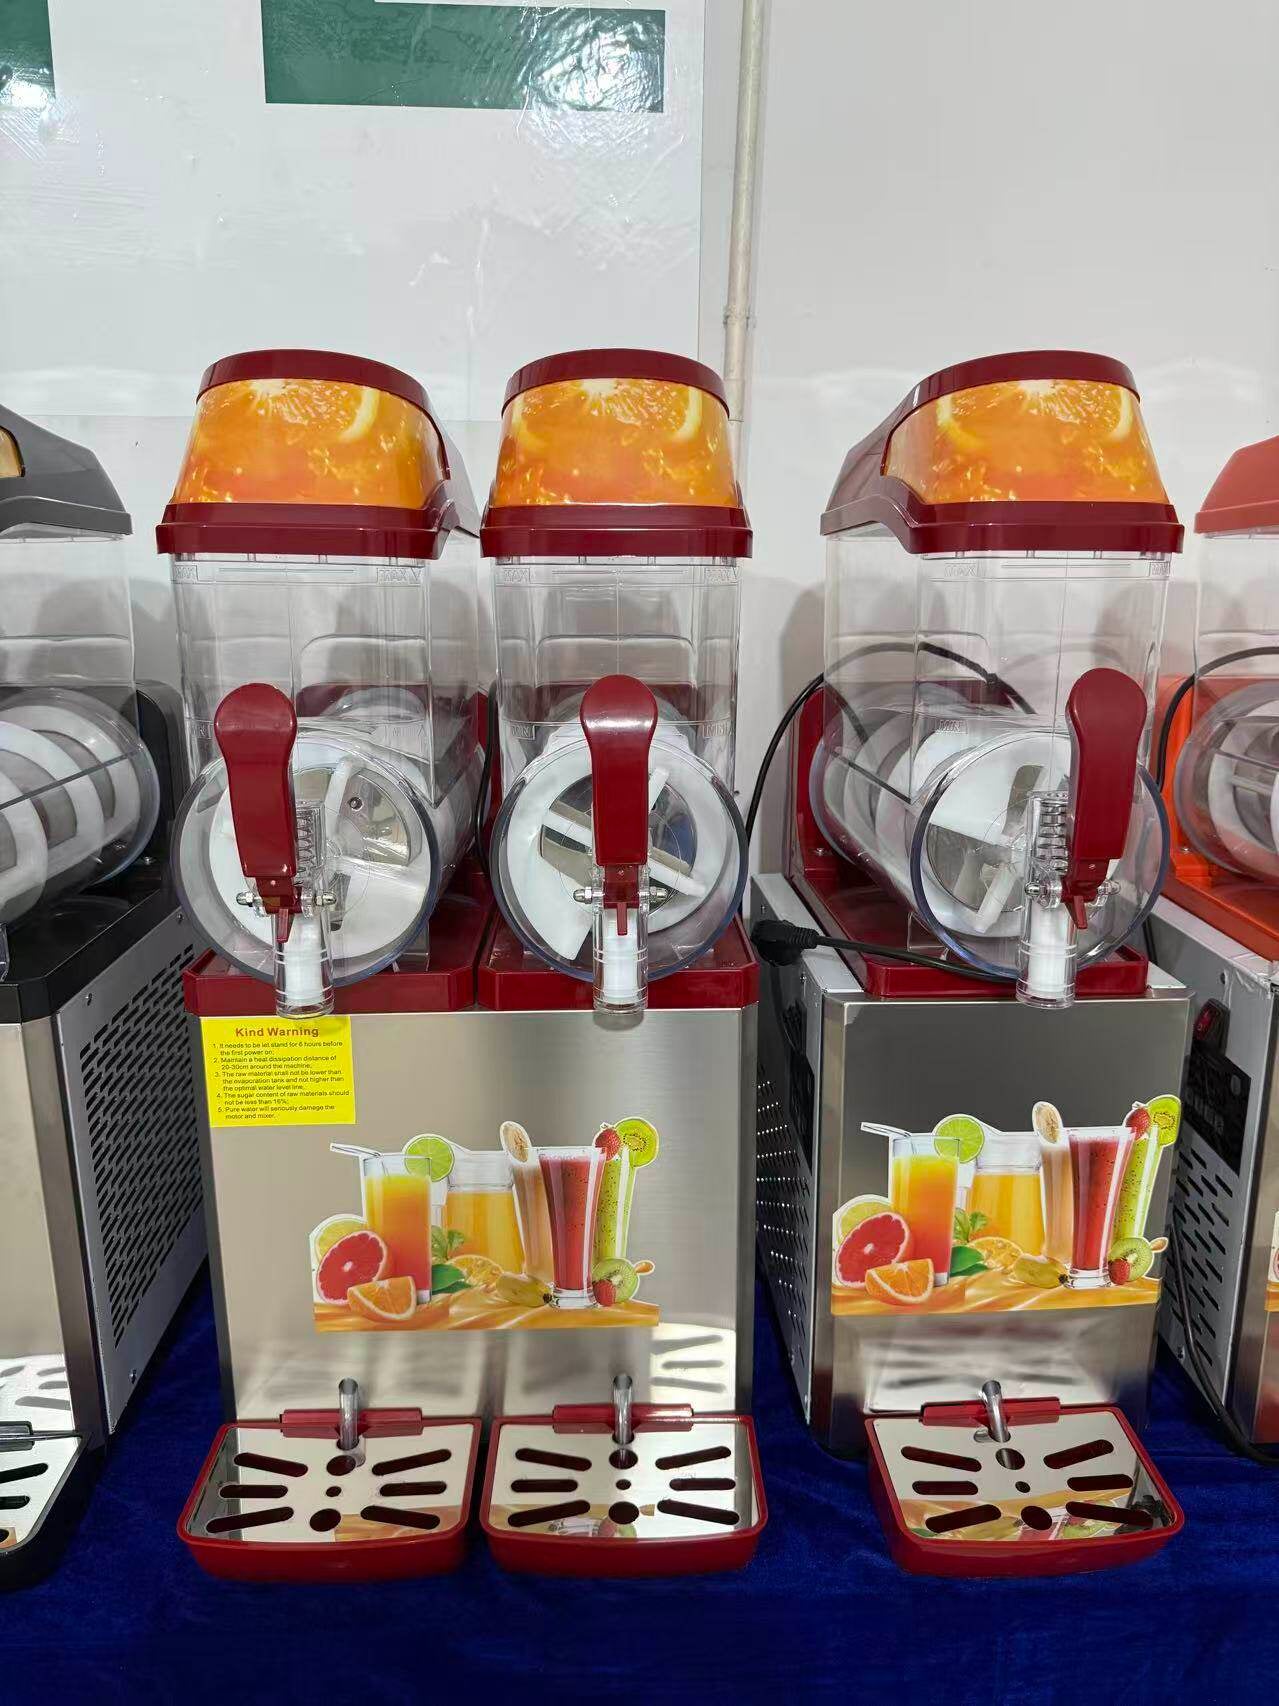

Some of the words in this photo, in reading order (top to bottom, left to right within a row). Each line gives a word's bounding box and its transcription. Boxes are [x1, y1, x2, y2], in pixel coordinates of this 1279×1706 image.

[235, 1027, 264, 1037] Kind
[267, 1026, 319, 1038] Warning
[309, 1076, 330, 1084] higher
